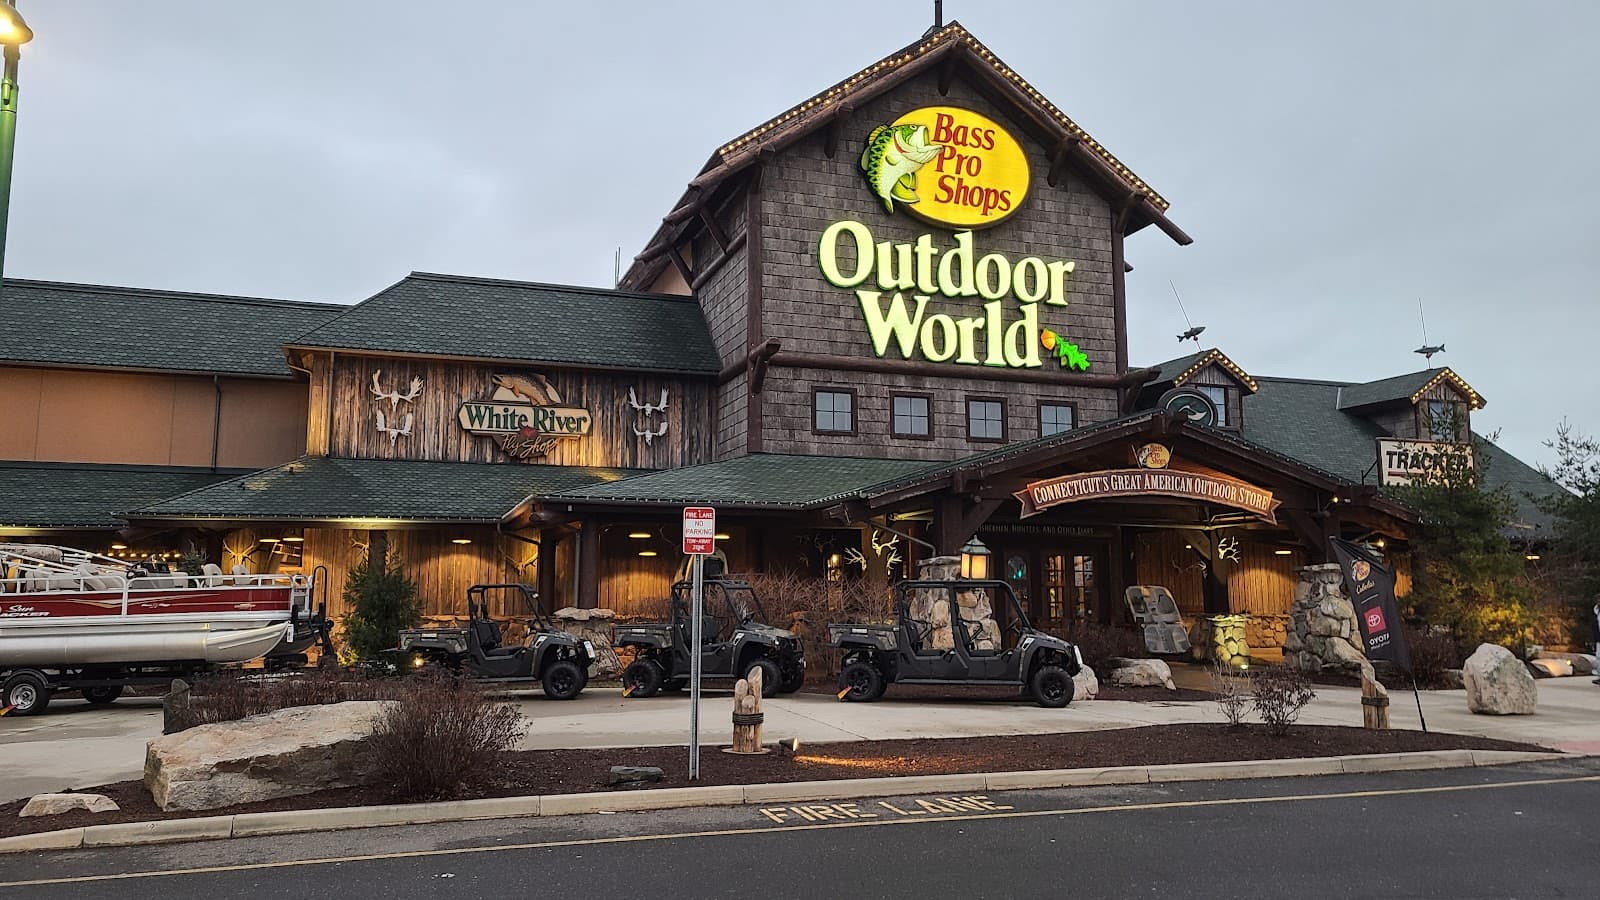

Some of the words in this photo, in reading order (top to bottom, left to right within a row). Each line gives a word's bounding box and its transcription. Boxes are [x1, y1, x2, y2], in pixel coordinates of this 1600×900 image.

[932, 112, 995, 151] Bass
[935, 145, 982, 178] Pro
[934, 175, 1011, 216] Shops
[818, 220, 1075, 306] Outdoor
[855, 290, 1043, 368] World
[464, 404, 528, 429] White
[533, 407, 587, 432] River
[501, 434, 519, 456] Fly
[519, 438, 559, 458] Shop
[1033, 476, 1109, 504] CONNECTICUT'S
[1110, 474, 1142, 491] GREAT
[1144, 474, 1192, 493] AMERICAN
[1194, 477, 1237, 501] OUTDOOR
[1238, 487, 1269, 510] STORE
[686, 511, 698, 519] FIRE
[699, 511, 713, 519] LANE
[685, 528, 713, 536] PARKING
[9, 604, 35, 613] Sun
[759, 803, 878, 824] FIRE
[878, 795, 1014, 816] LANE
